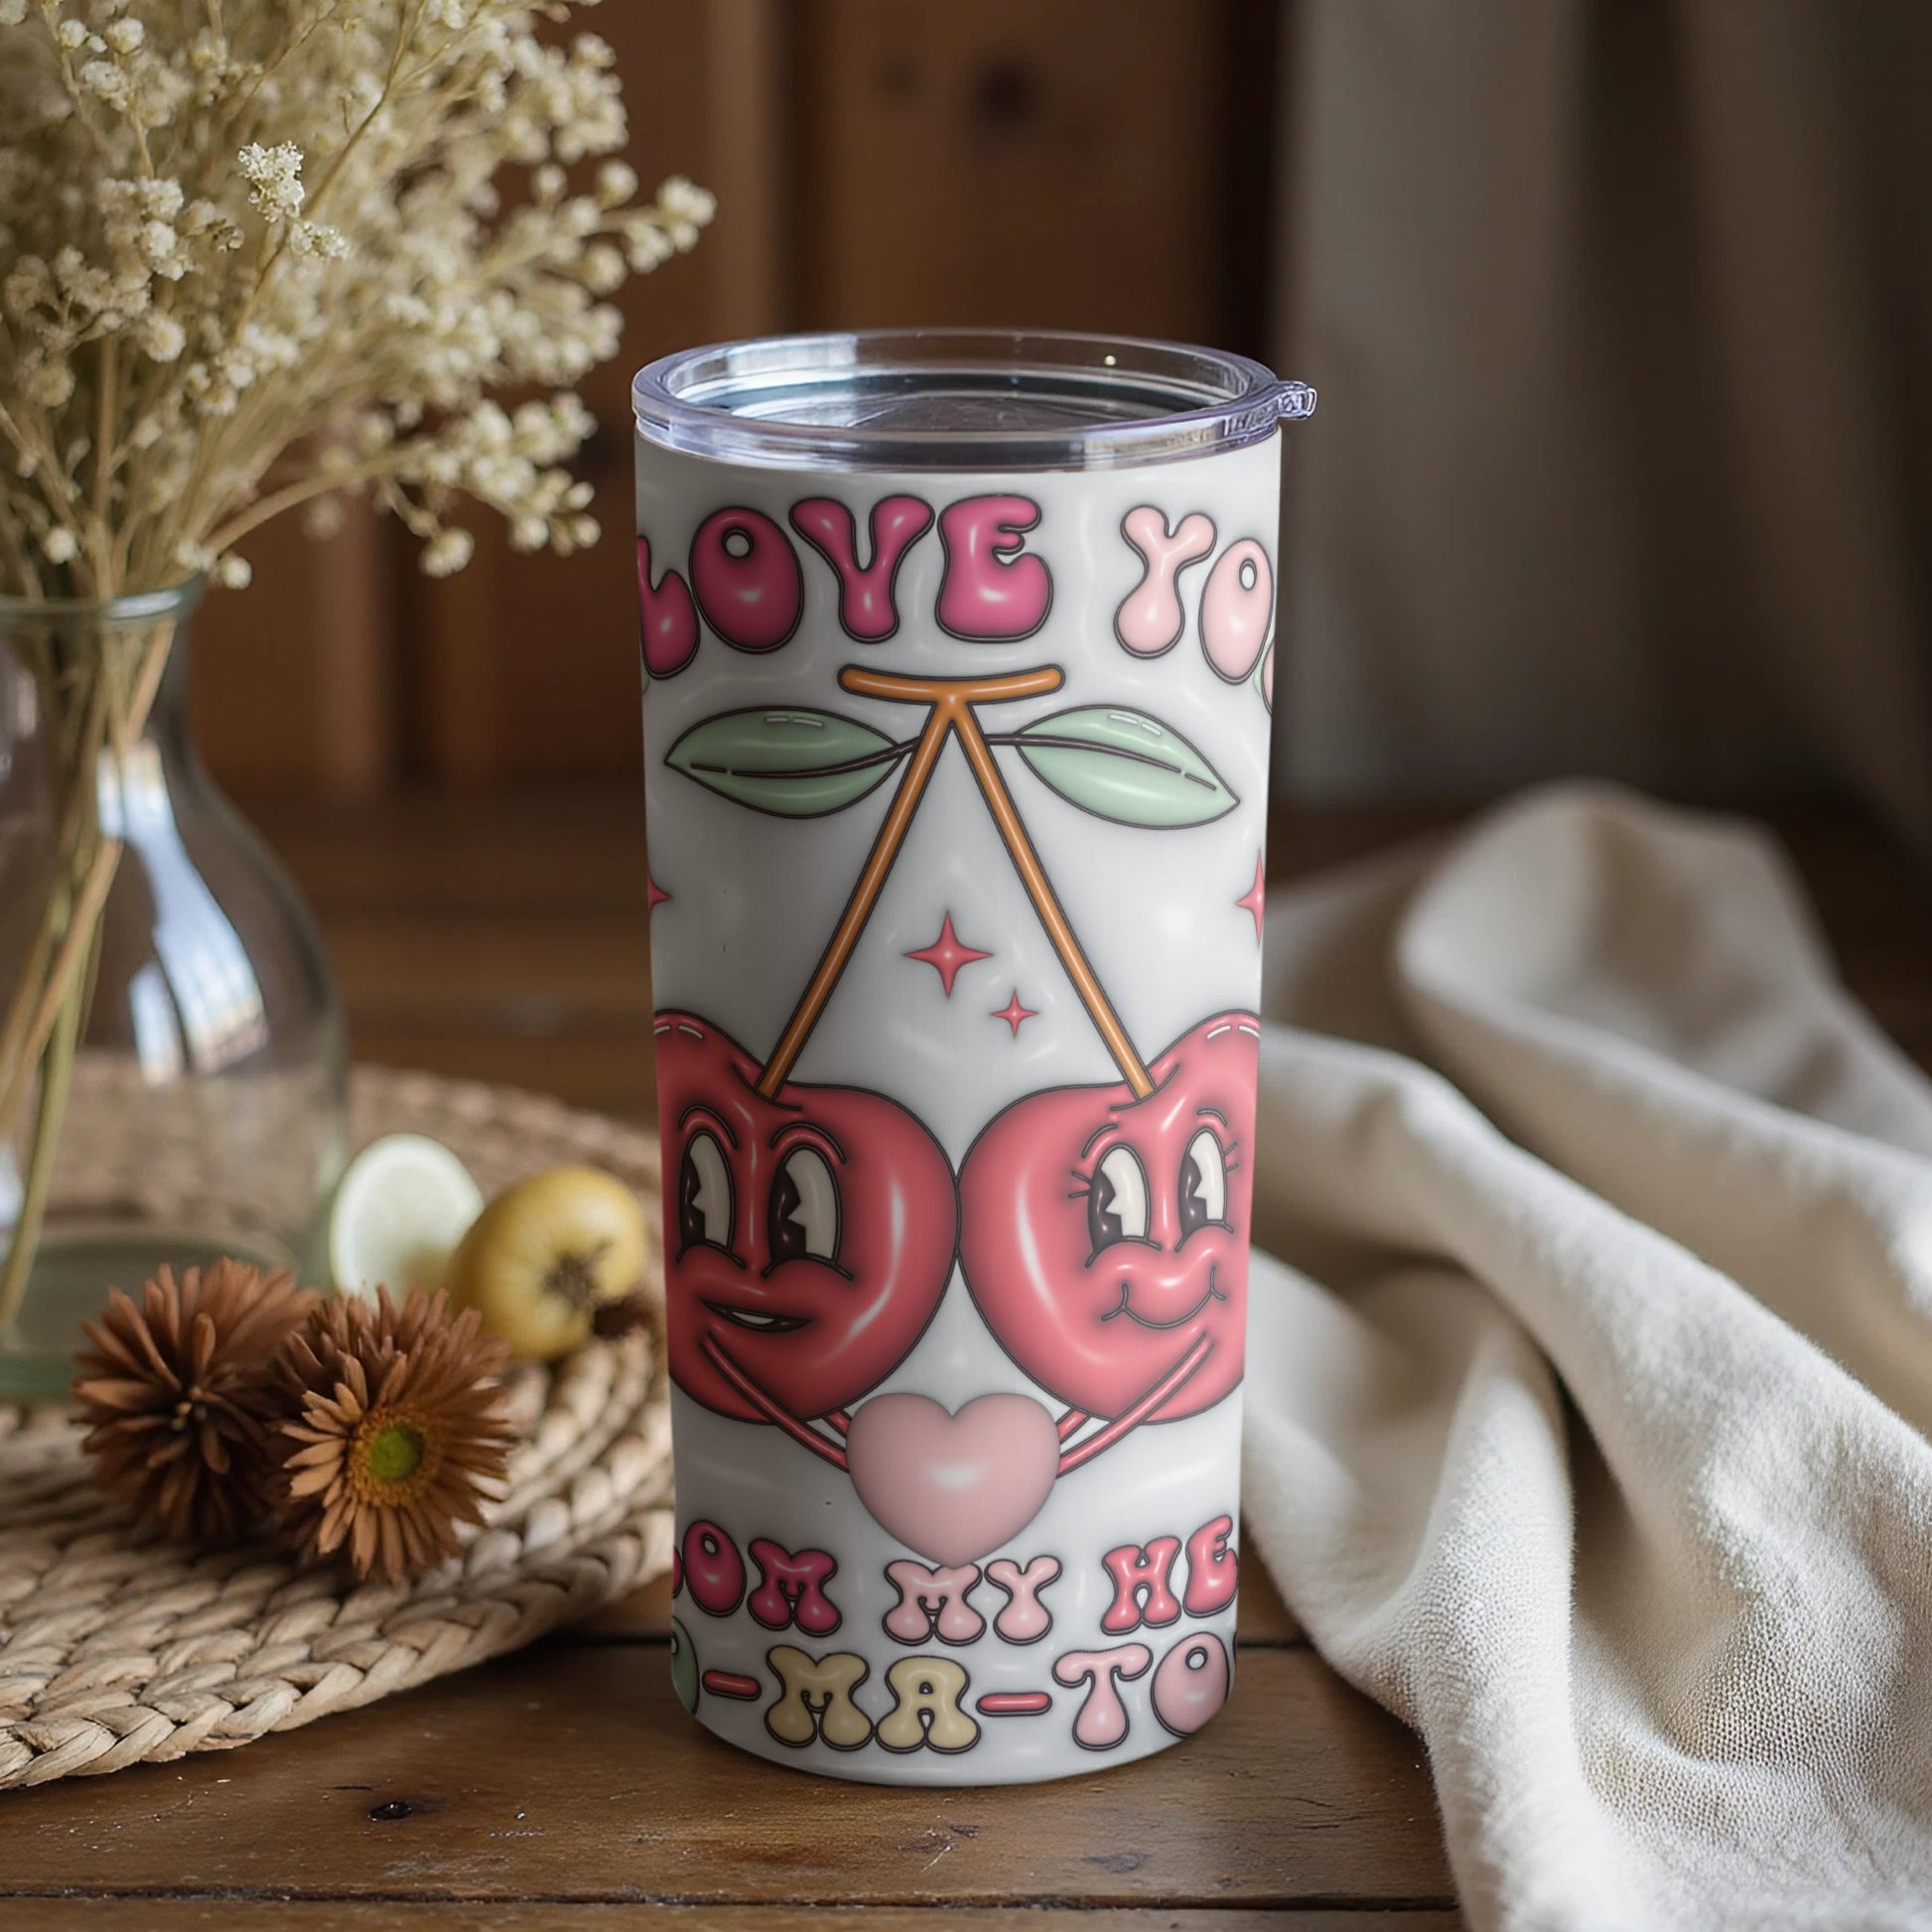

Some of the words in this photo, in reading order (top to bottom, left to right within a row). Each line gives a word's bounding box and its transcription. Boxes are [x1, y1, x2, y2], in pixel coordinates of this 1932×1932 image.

[1114, 504, 1275, 717] YO
[672, 1519, 843, 1638] OM
[882, 1555, 1063, 1647] MY
[1100, 1514, 1239, 1636] HE
